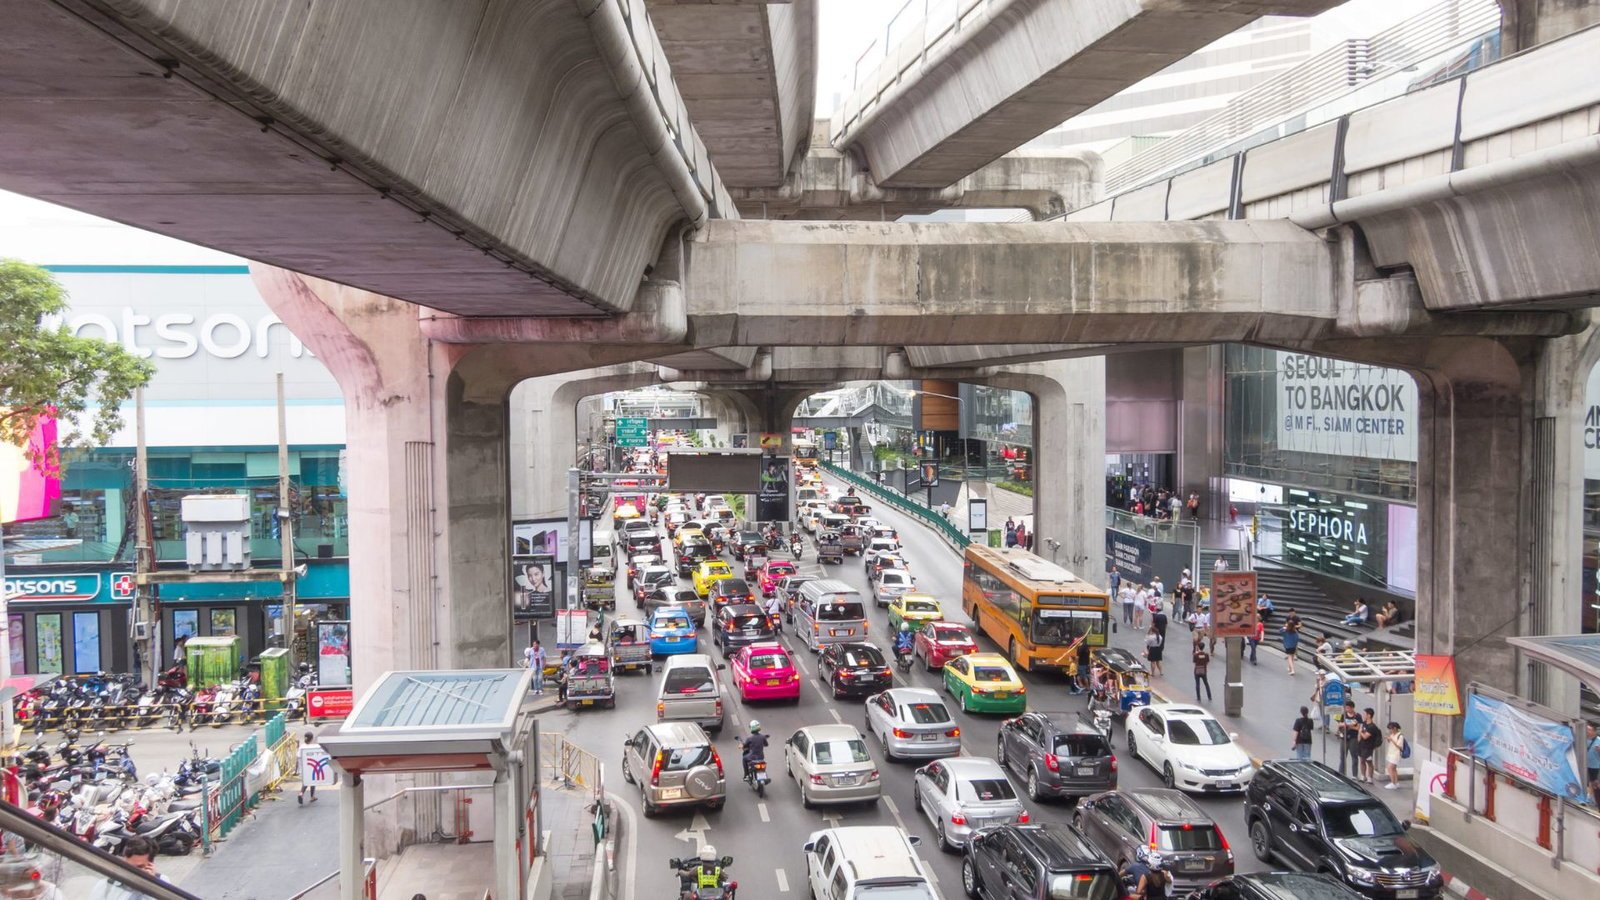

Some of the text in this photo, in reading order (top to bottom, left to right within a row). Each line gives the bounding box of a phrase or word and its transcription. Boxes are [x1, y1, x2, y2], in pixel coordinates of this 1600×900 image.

[1285, 355, 1341, 380] SEOUL
[1285, 384, 1405, 411] TO BANGKOK
[1323, 416, 1352, 432] SIAM
[1355, 417, 1405, 435] CENTER
[1289, 509, 1367, 545] SEPHORA
[5, 579, 77, 594] atsons
